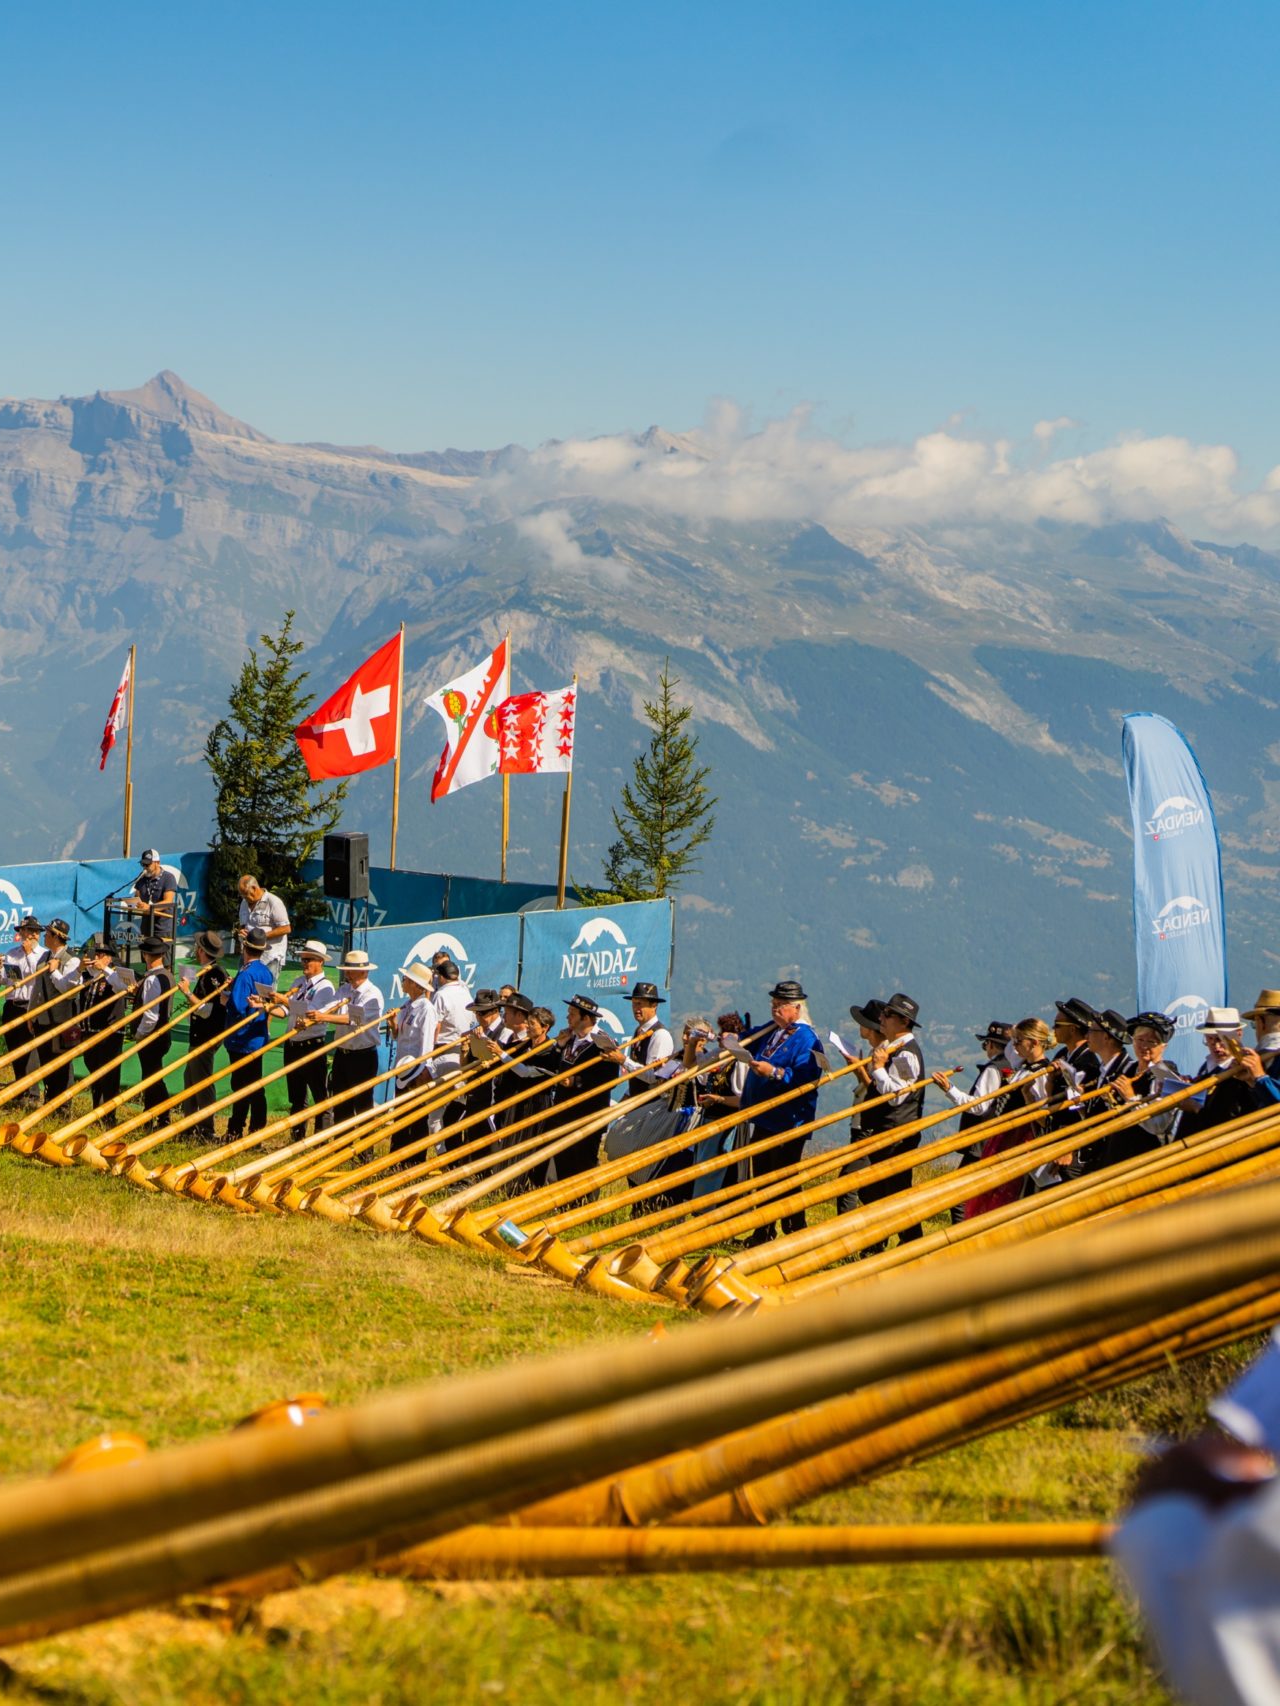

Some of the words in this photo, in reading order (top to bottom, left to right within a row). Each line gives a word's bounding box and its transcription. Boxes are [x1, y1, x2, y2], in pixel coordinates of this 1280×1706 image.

[560, 946, 638, 979] NENDAZ
[586, 979, 591, 988] 4
[593, 975, 620, 988] VALLÉES
